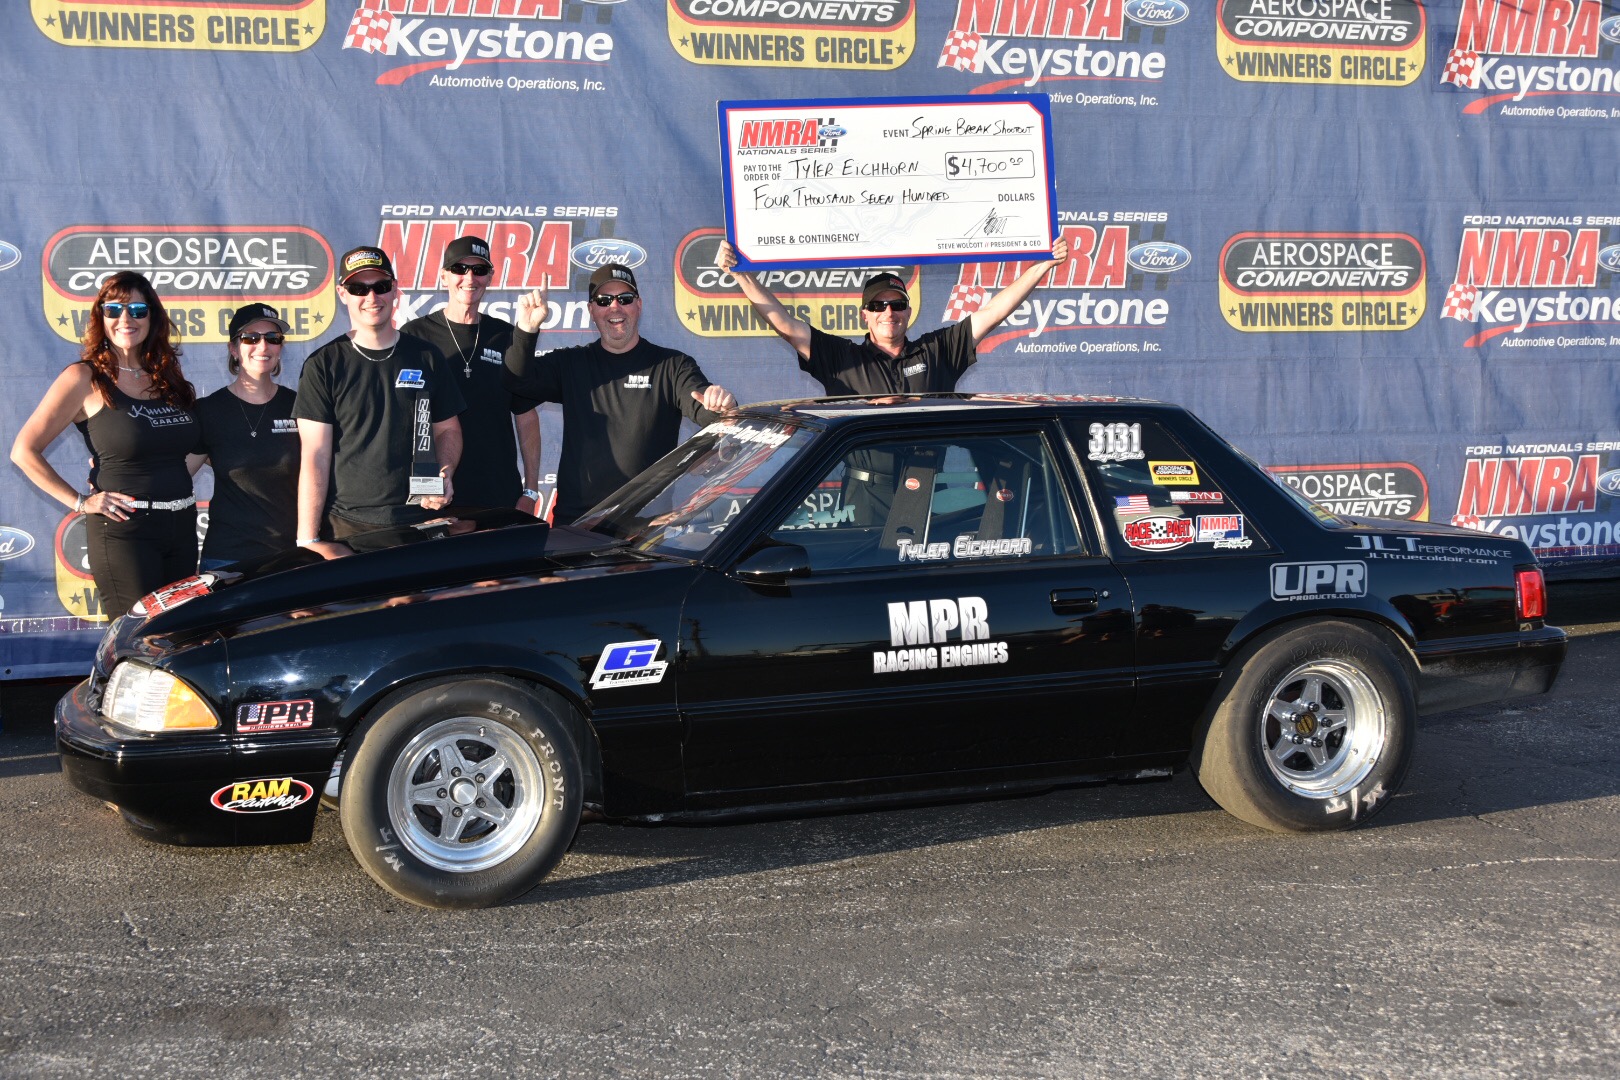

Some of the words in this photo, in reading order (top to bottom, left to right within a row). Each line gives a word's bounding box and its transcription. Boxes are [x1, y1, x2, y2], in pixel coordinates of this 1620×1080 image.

[689, 0, 895, 22] COMPONENTS
[1249, 0, 1393, 20] AEROSPACE
[58, 10, 195, 43] WINNERS
[207, 15, 300, 46] CIRCLE
[955, 0, 1126, 41] NMRA
[1136, 0, 1176, 20] Ford
[1234, 19, 1408, 42] COMPONENTS
[1454, 0, 1602, 58] NMRA
[386, 18, 614, 71] Keystone
[691, 32, 805, 63] WINNERS
[815, 36, 894, 65] CIRCLE
[974, 39, 1166, 87] Keystone
[1236, 51, 1332, 79] WINNERS
[1340, 55, 1406, 81] CIRCLE
[429, 74, 504, 88] Automotive
[506, 76, 580, 92] Operations,
[583, 78, 606, 91] Inc.
[1075, 92, 1137, 107] Operations,
[1139, 94, 1159, 106] Inc.
[1500, 105, 1555, 117] Automotive
[1556, 106, 1609, 119] Operations,
[739, 118, 820, 149] NMRA
[883, 129, 909, 138] EVENT
[737, 148, 797, 156] NATIONALS
[743, 165, 756, 173] PAY
[757, 164, 767, 172] TO
[768, 164, 782, 172] THE
[744, 173, 769, 181] ORDER
[771, 173, 781, 181] OF
[997, 193, 1035, 202] DOLLARS
[380, 205, 434, 216] FORD
[439, 205, 548, 217] NATIONALS
[553, 206, 619, 218] SERIES
[1057, 211, 1109, 222] ONALS
[1113, 211, 1168, 222] SERIES
[1463, 216, 1501, 225] FORD
[1505, 216, 1582, 226] NATIONALS
[757, 236, 786, 245] PURSE
[789, 235, 796, 244] &
[799, 233, 860, 244] CONTINGENCY
[88, 237, 288, 265] AEROSPACE
[585, 244, 631, 266] Ford
[1140, 247, 1178, 267] Ford
[1251, 242, 1394, 266] AEROSPACE
[1453, 228, 1601, 288] NMRA
[68, 270, 311, 291] CPONENTS
[1236, 270, 1409, 287] COMPONENTS
[1238, 302, 1333, 327] WINNERS
[1341, 301, 1407, 326] CIRCLE
[1014, 341, 1077, 354] Automotive
[1079, 341, 1140, 355] Operations,
[1143, 341, 1162, 352] Inc.
[1500, 336, 1555, 347] Automotive
[1556, 336, 1607, 349] Operations,
[152, 415, 191, 425] GARAGE
[417, 398, 431, 452] NMRA
[1088, 422, 1142, 454] 3131
[1465, 446, 1503, 456] FORD
[1506, 442, 1583, 455] NATIONALS
[1189, 491, 1223, 500] DYNO
[1456, 454, 1600, 518] NMRA
[1125, 522, 1152, 540] RACE
[1166, 520, 1191, 537] PART
[1200, 516, 1239, 531] NMRA
[1345, 534, 1421, 552] JLT
[1418, 544, 1512, 559] PERFORMANCE
[1365, 552, 1498, 565] JLTtruecoldair.com
[1273, 563, 1365, 596] UPR
[1289, 593, 1358, 602] PRODUCTS.COM
[887, 596, 990, 647] MPR
[873, 647, 938, 674] RACING
[941, 641, 1009, 668] ENGINES
[598, 667, 663, 682] FORCE
[239, 702, 313, 726] UPR
[487, 700, 522, 721] ET
[529, 728, 566, 811] FRONT
[231, 779, 291, 801] RAM
[222, 794, 303, 809] Clutches
